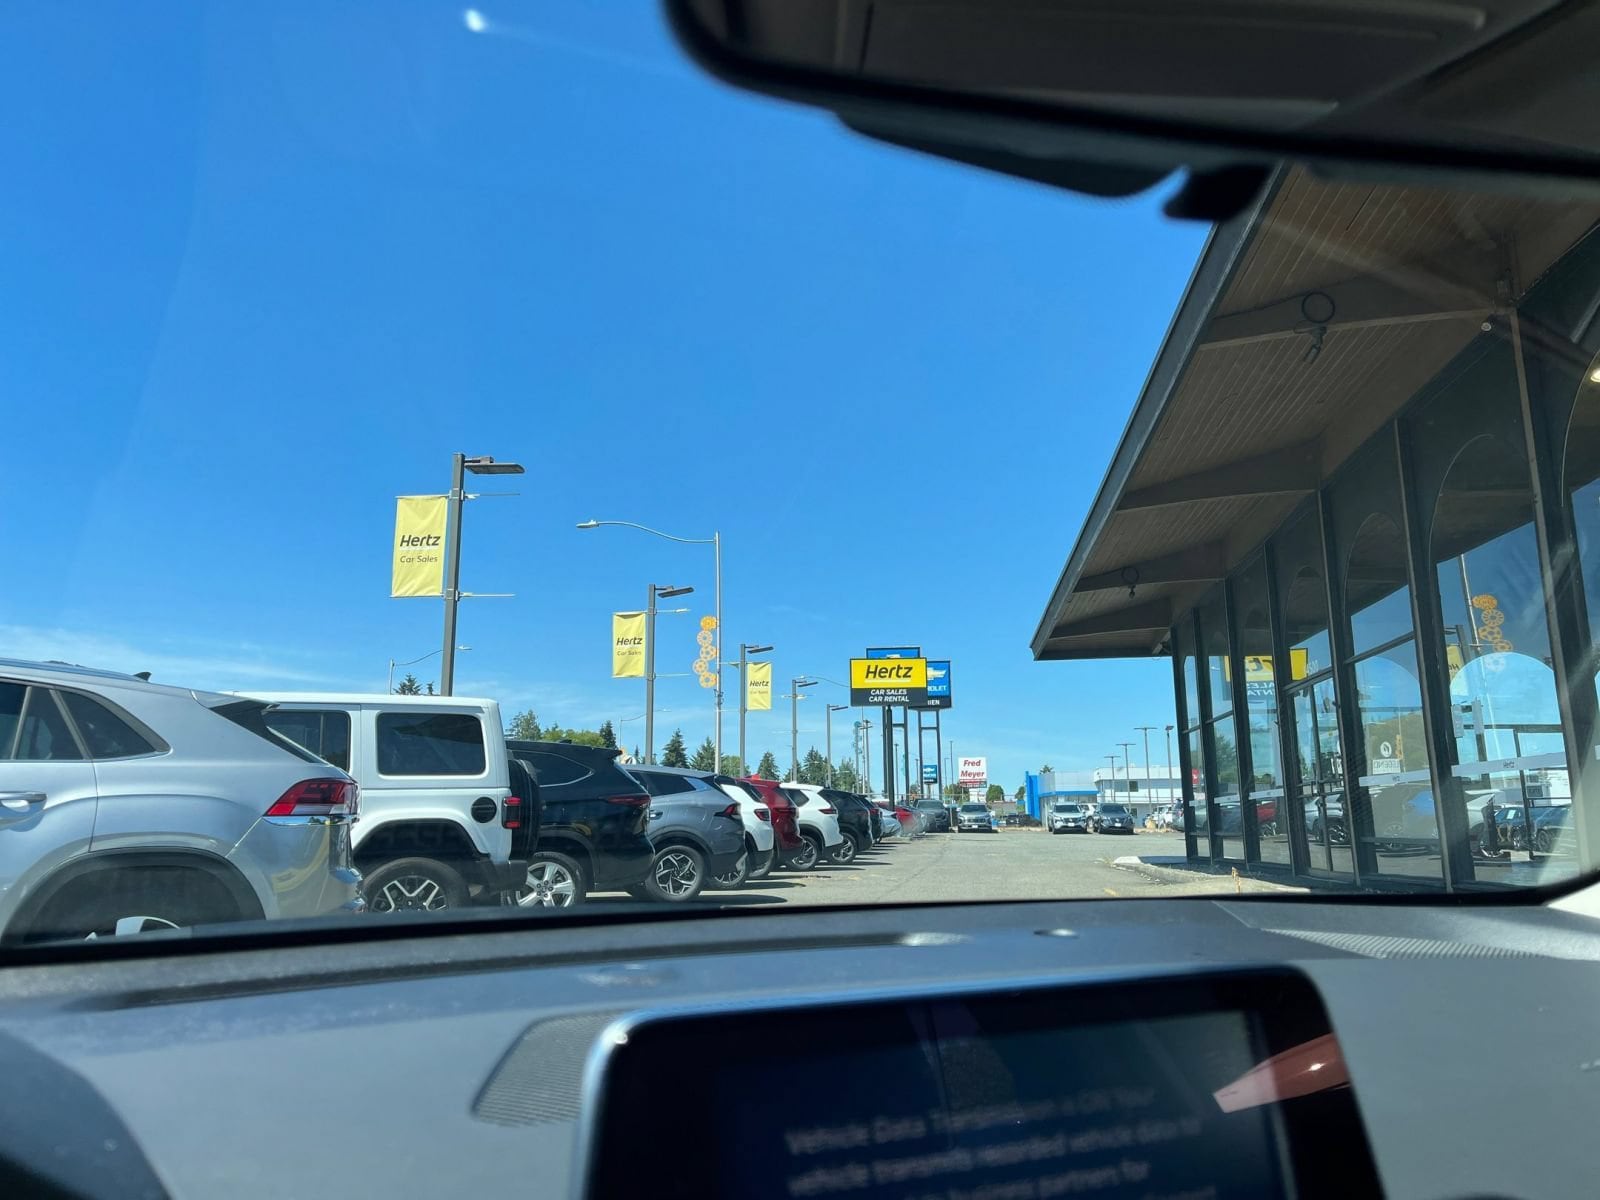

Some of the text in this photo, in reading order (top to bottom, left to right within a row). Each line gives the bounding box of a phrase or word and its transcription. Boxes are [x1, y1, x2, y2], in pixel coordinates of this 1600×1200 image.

[399, 534, 441, 547] Hertz
[399, 555, 438, 564] Car Sales
[616, 636, 643, 646] Hertz
[865, 664, 913, 679] Hertz
[963, 759, 981, 767] Fred
[960, 770, 985, 779] Meyer
